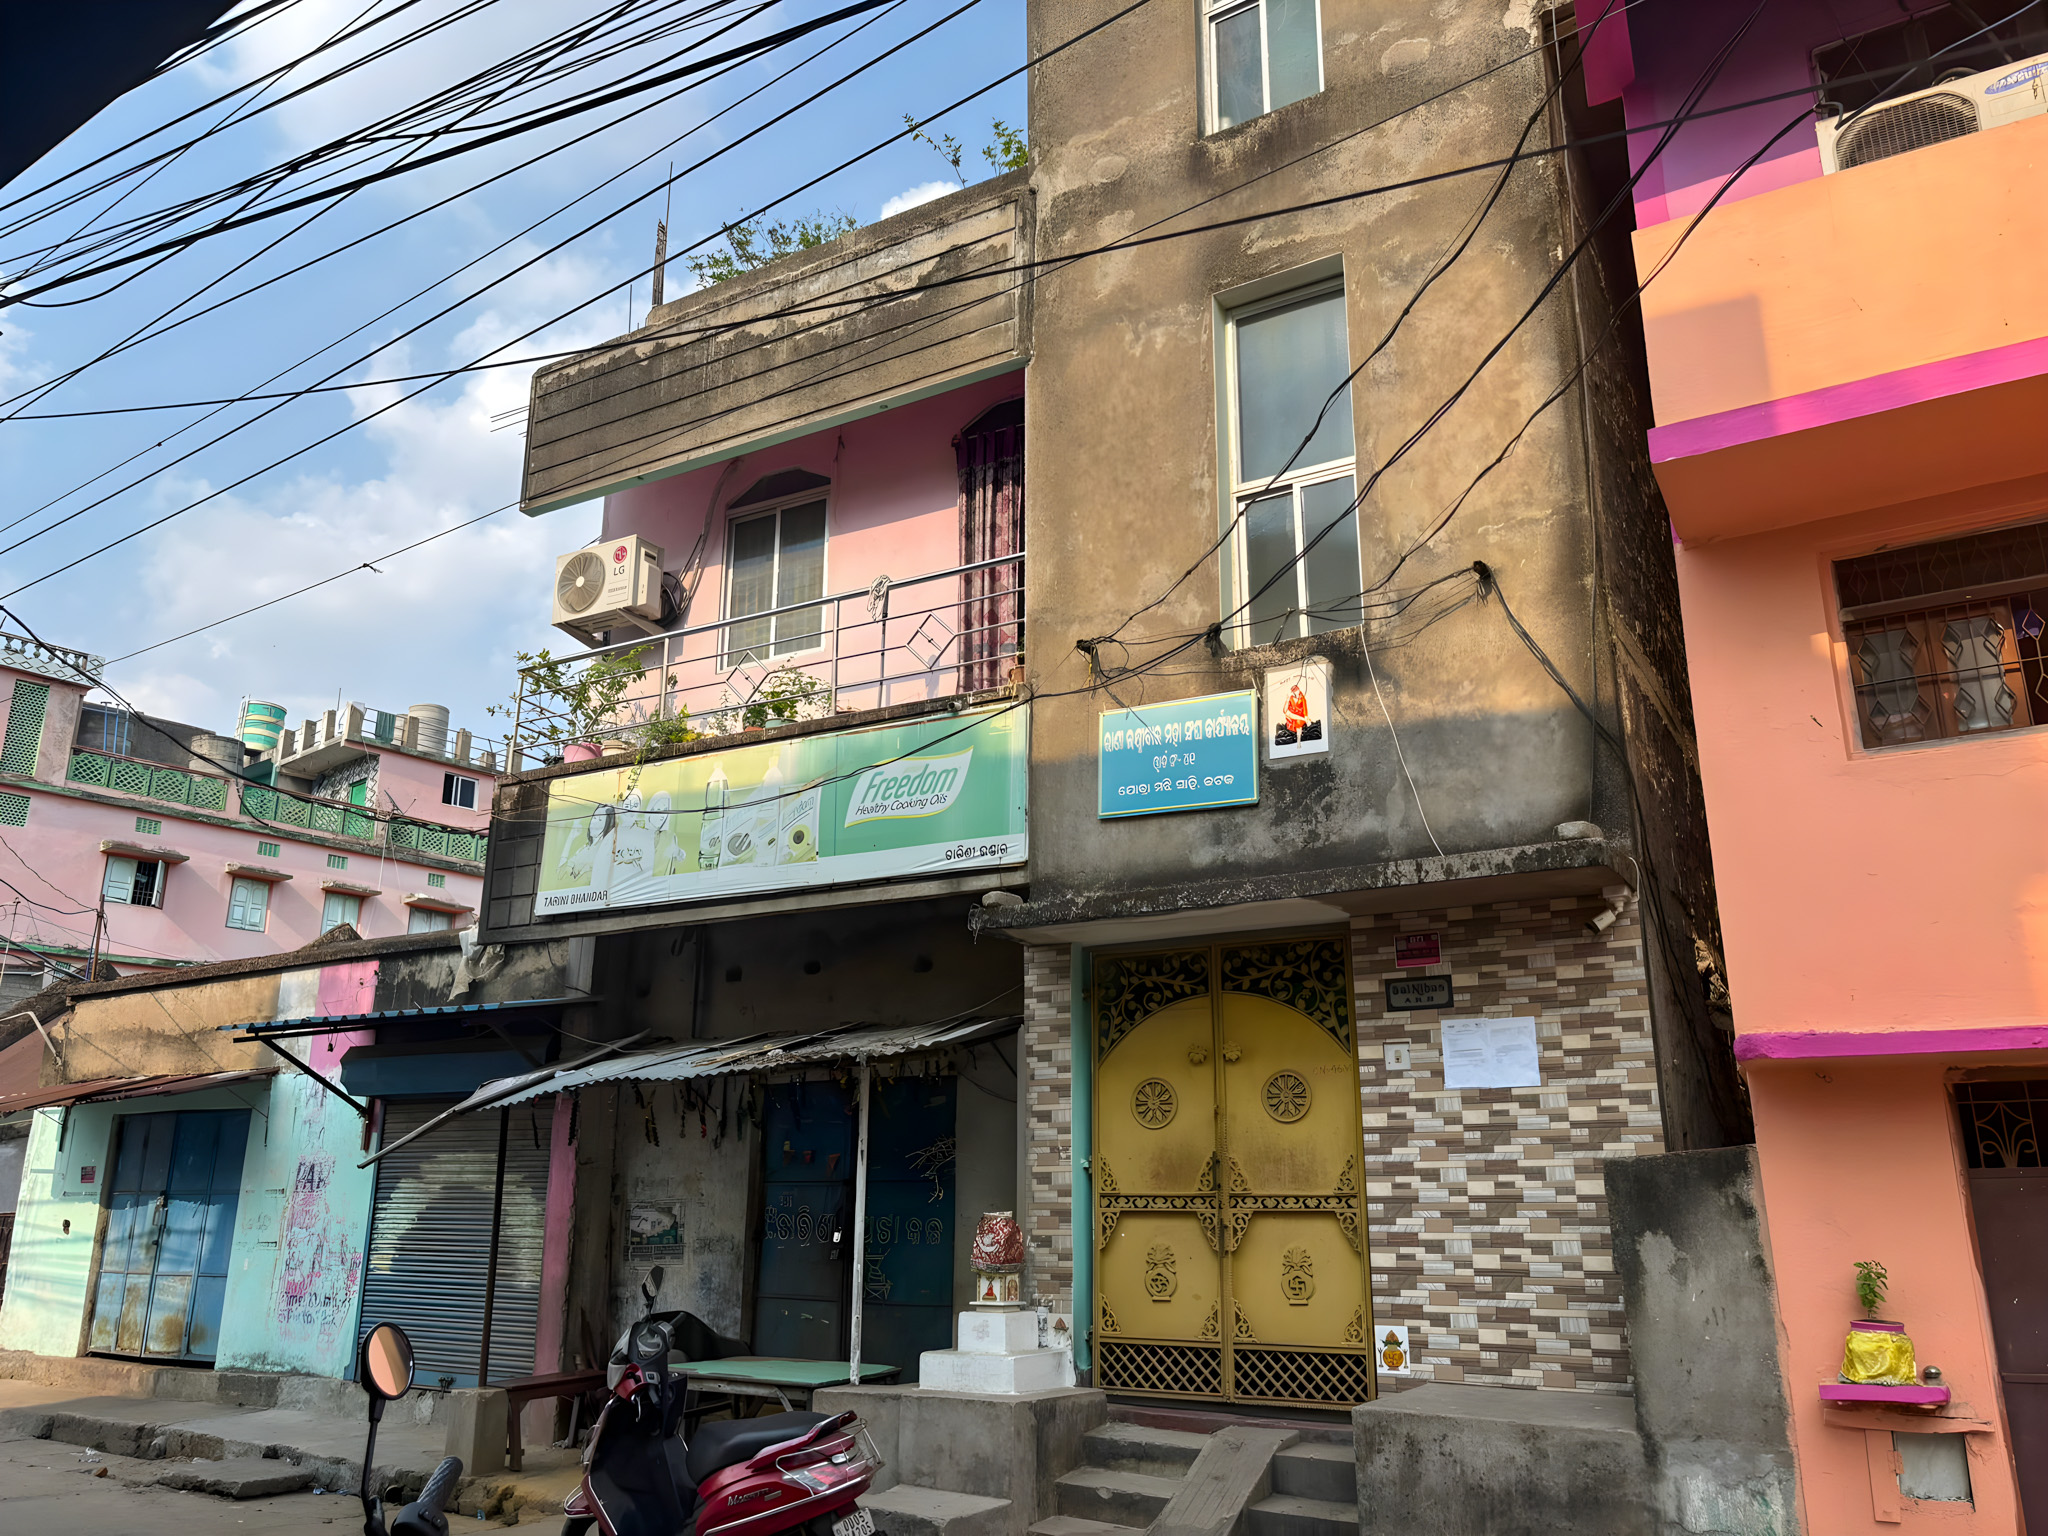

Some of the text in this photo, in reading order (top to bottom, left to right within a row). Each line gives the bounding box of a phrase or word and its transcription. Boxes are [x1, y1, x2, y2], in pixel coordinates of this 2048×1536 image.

[613, 565, 625, 576] LG
[861, 763, 958, 804] Freedom
[855, 793, 948, 815] Healthy Cooking Oils
[544, 890, 608, 907] TARINI BHANDAR
